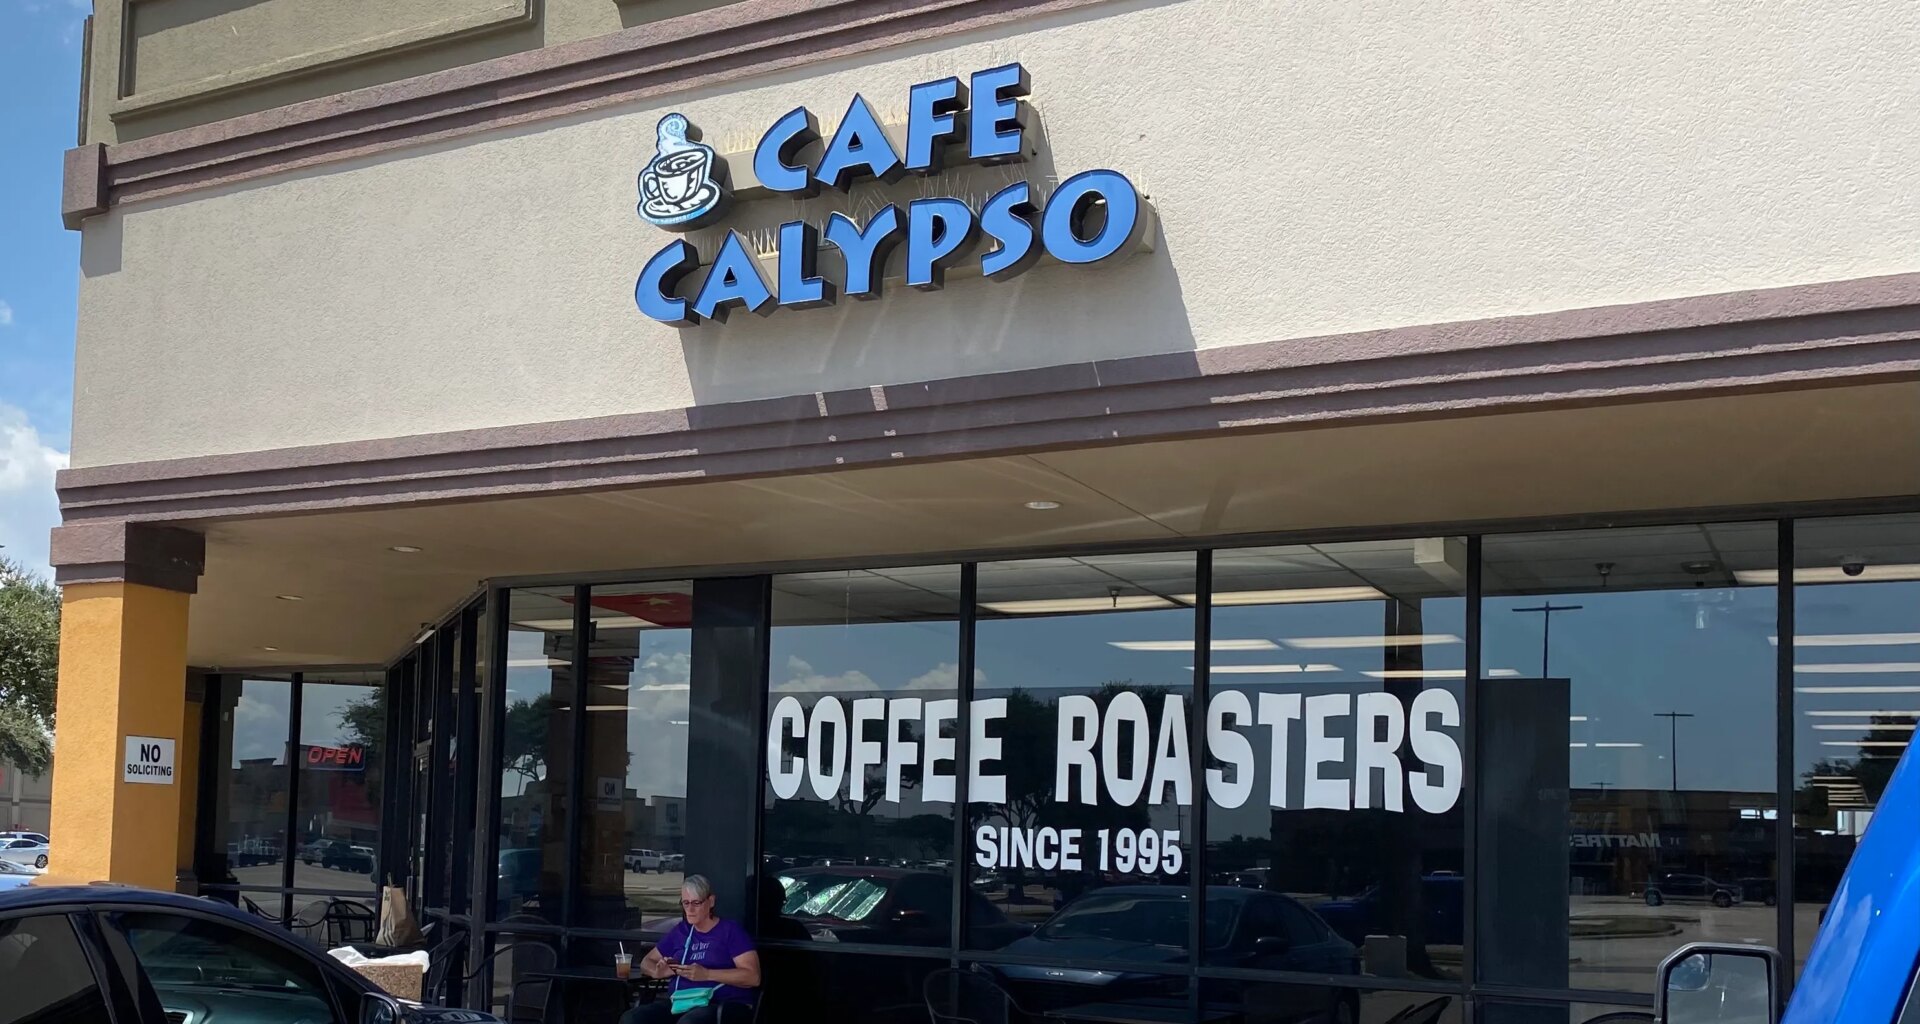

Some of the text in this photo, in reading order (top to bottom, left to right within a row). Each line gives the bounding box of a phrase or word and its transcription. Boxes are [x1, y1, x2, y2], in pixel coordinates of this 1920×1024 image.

[753, 62, 1024, 193] CAFE
[634, 168, 1139, 323] CALYPSO
[127, 763, 172, 777] SOLICITING
[140, 743, 161, 763] NO
[308, 746, 362, 764] OPEN
[767, 688, 1463, 814] COFFEE ROASTERS
[976, 825, 1183, 875] SINCE 1995
